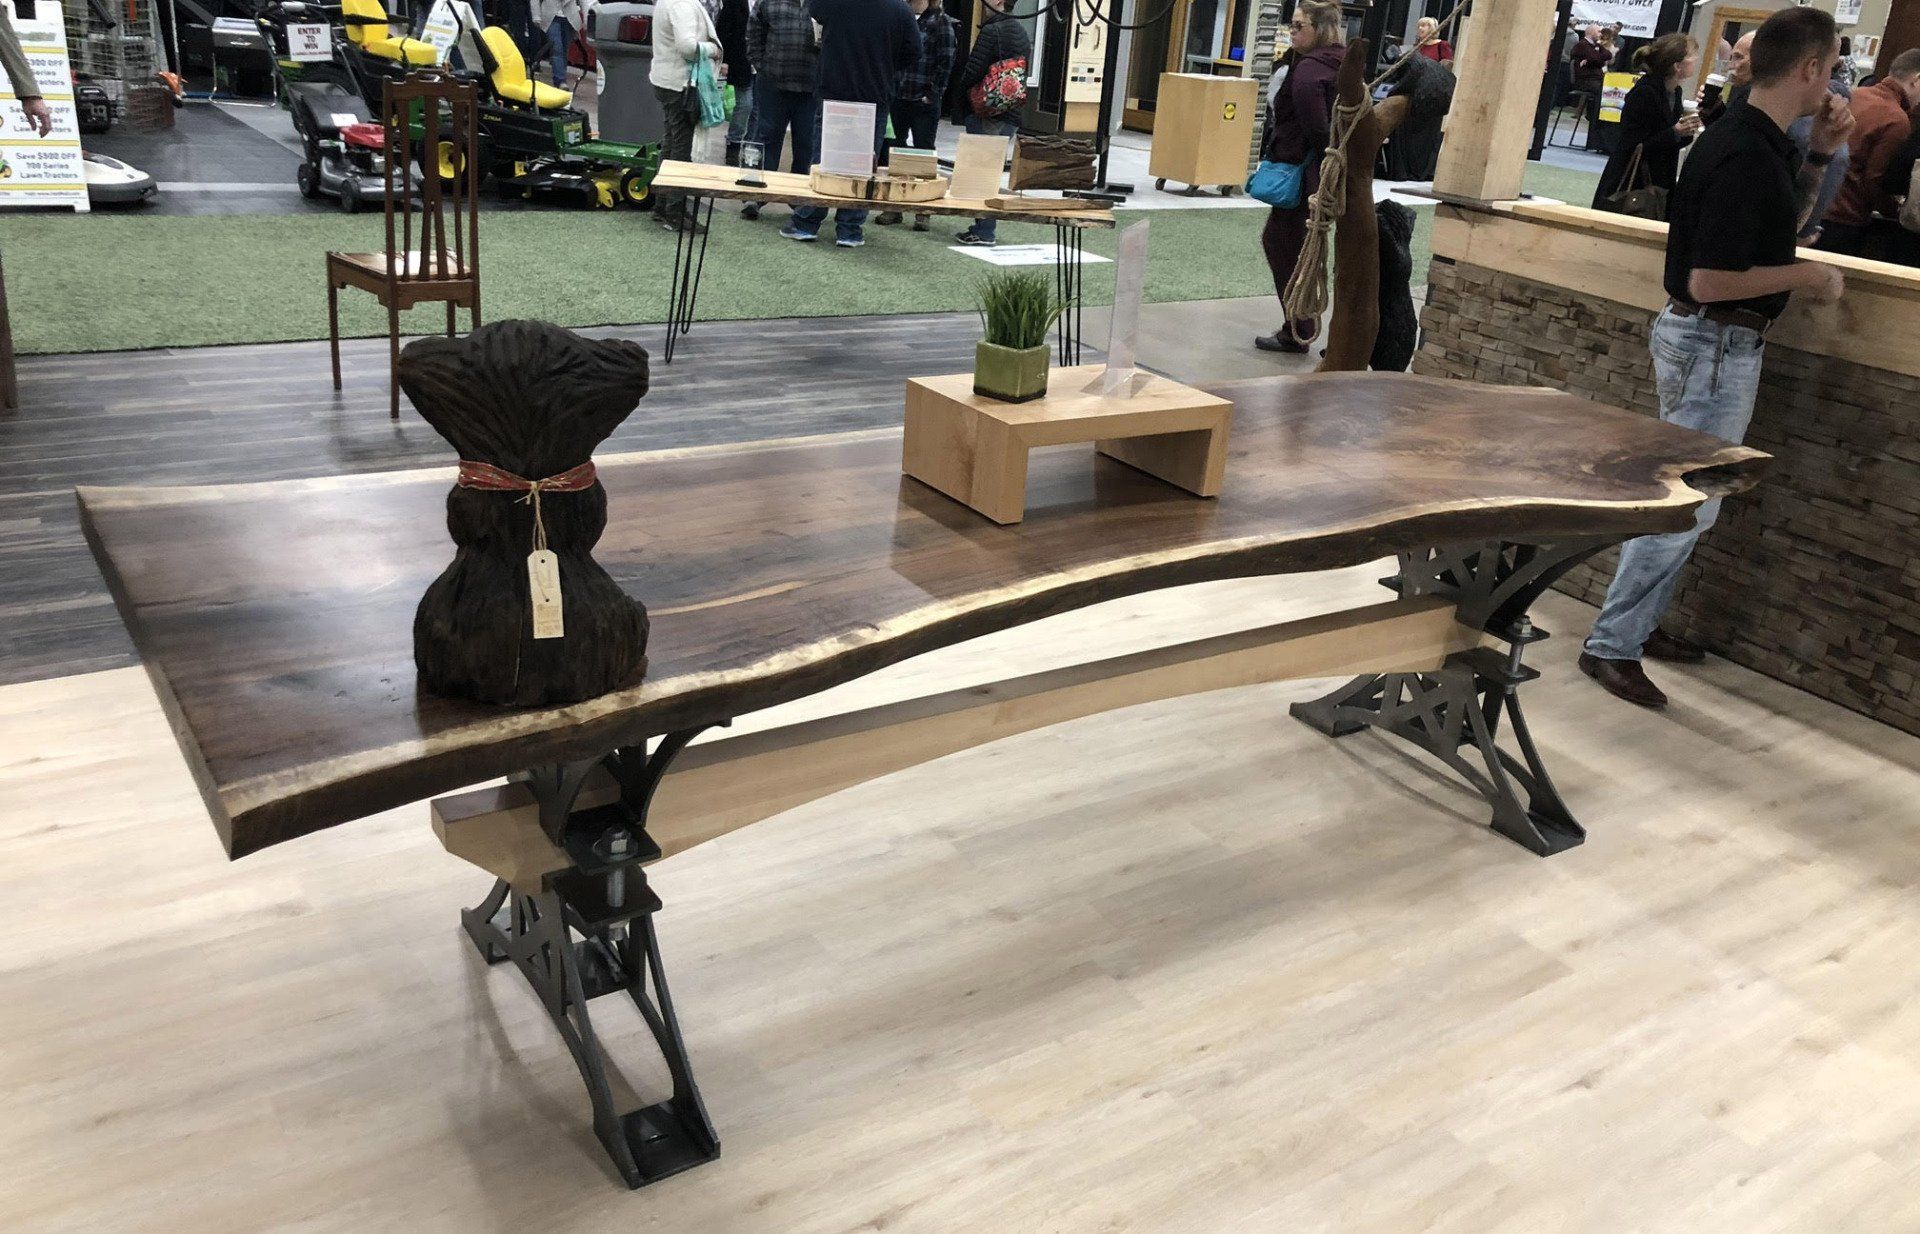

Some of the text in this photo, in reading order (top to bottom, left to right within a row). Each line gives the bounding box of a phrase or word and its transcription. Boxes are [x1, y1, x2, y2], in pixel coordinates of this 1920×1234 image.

[298, 27, 321, 35] ENTER
[16, 152, 36, 160] Save
[60, 152, 76, 160] OFF
[42, 162, 70, 170] Series
[43, 171, 78, 179] Tractors
